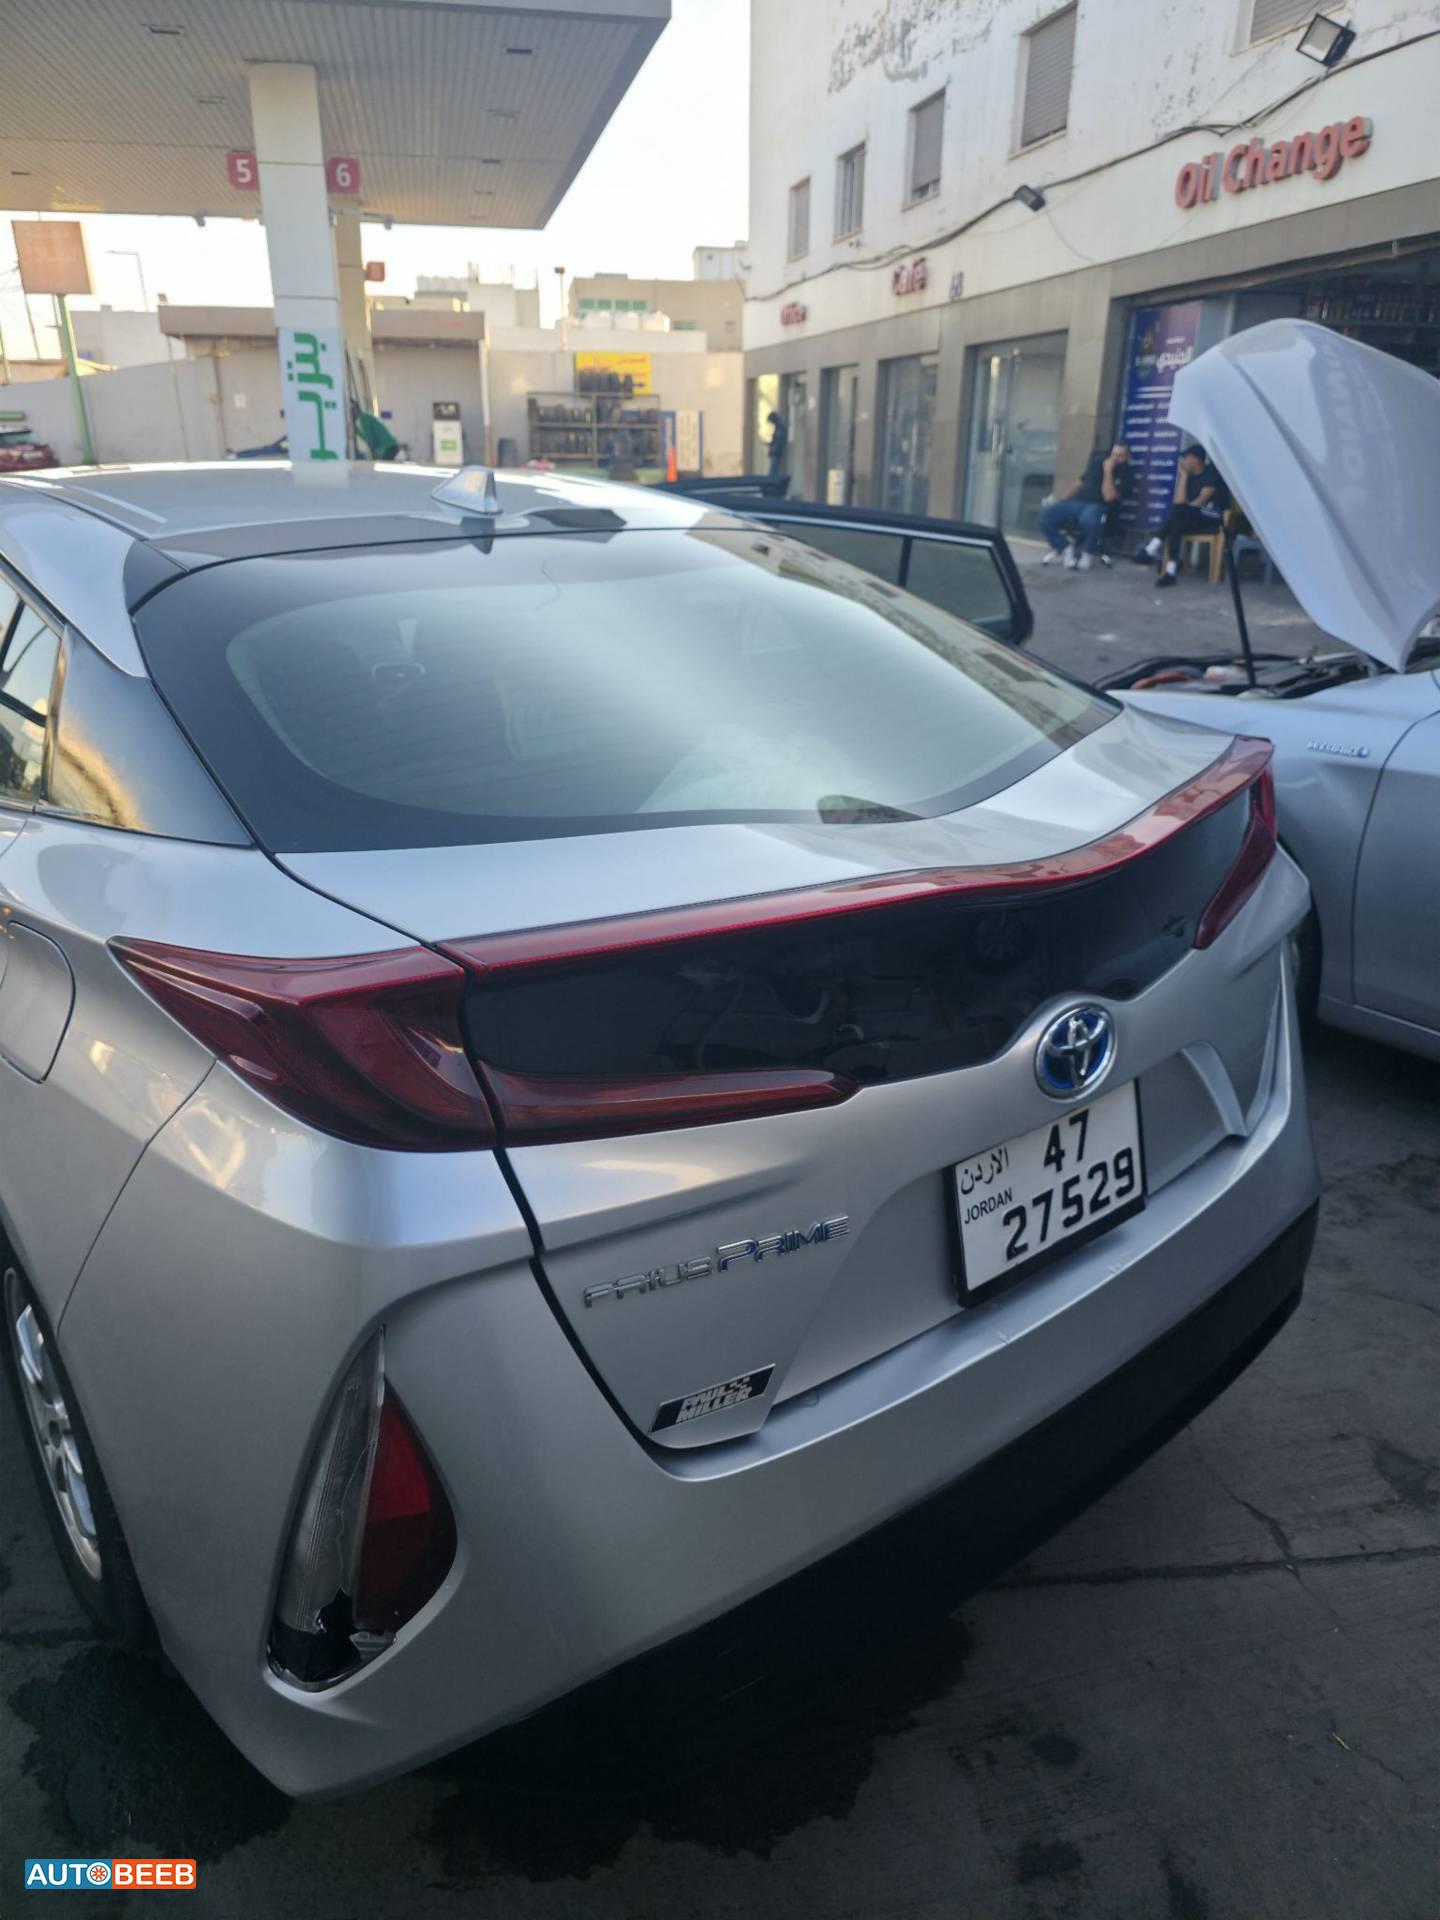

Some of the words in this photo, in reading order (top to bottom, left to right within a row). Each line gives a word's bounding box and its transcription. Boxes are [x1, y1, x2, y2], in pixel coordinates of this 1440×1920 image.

[236, 159, 251, 183] 5
[336, 163, 352, 187] 6
[1174, 153, 1222, 209] Oil
[1222, 116, 1373, 193] Change
[1044, 1109, 1088, 1173] 47
[964, 1187, 1013, 1224] JORDAN
[1002, 1147, 1135, 1261] 27529
[584, 1256, 713, 1308] PRIUS
[716, 1216, 848, 1272] PRIME
[676, 1386, 753, 1424] MILLER
